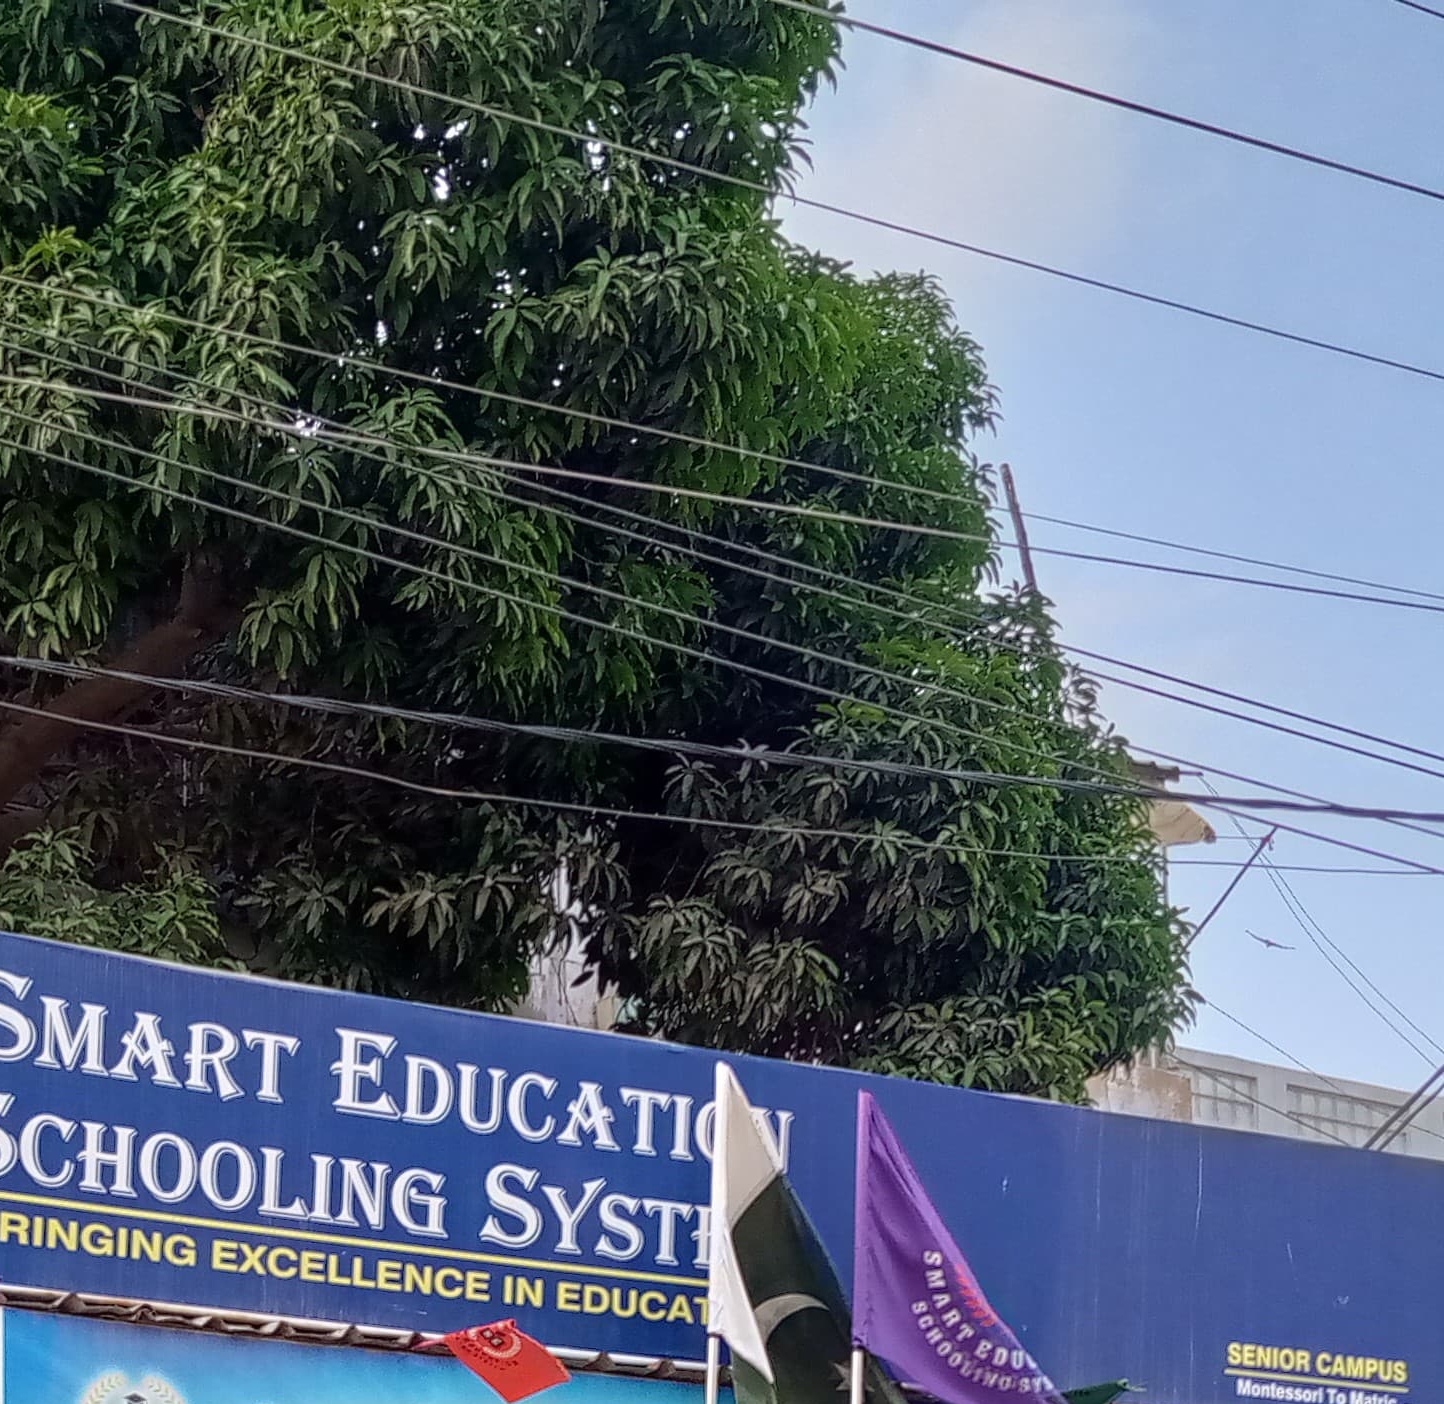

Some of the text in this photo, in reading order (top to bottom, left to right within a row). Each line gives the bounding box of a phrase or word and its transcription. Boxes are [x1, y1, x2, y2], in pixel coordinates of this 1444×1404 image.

[211, 1239, 492, 1304] EXCELLENCE
[503, 1274, 545, 1310] IN
[923, 1250, 975, 1342] SMART
[1226, 1341, 1408, 1383] SENIOR CAMPUS
[1236, 1378, 1324, 1403] Montessori
